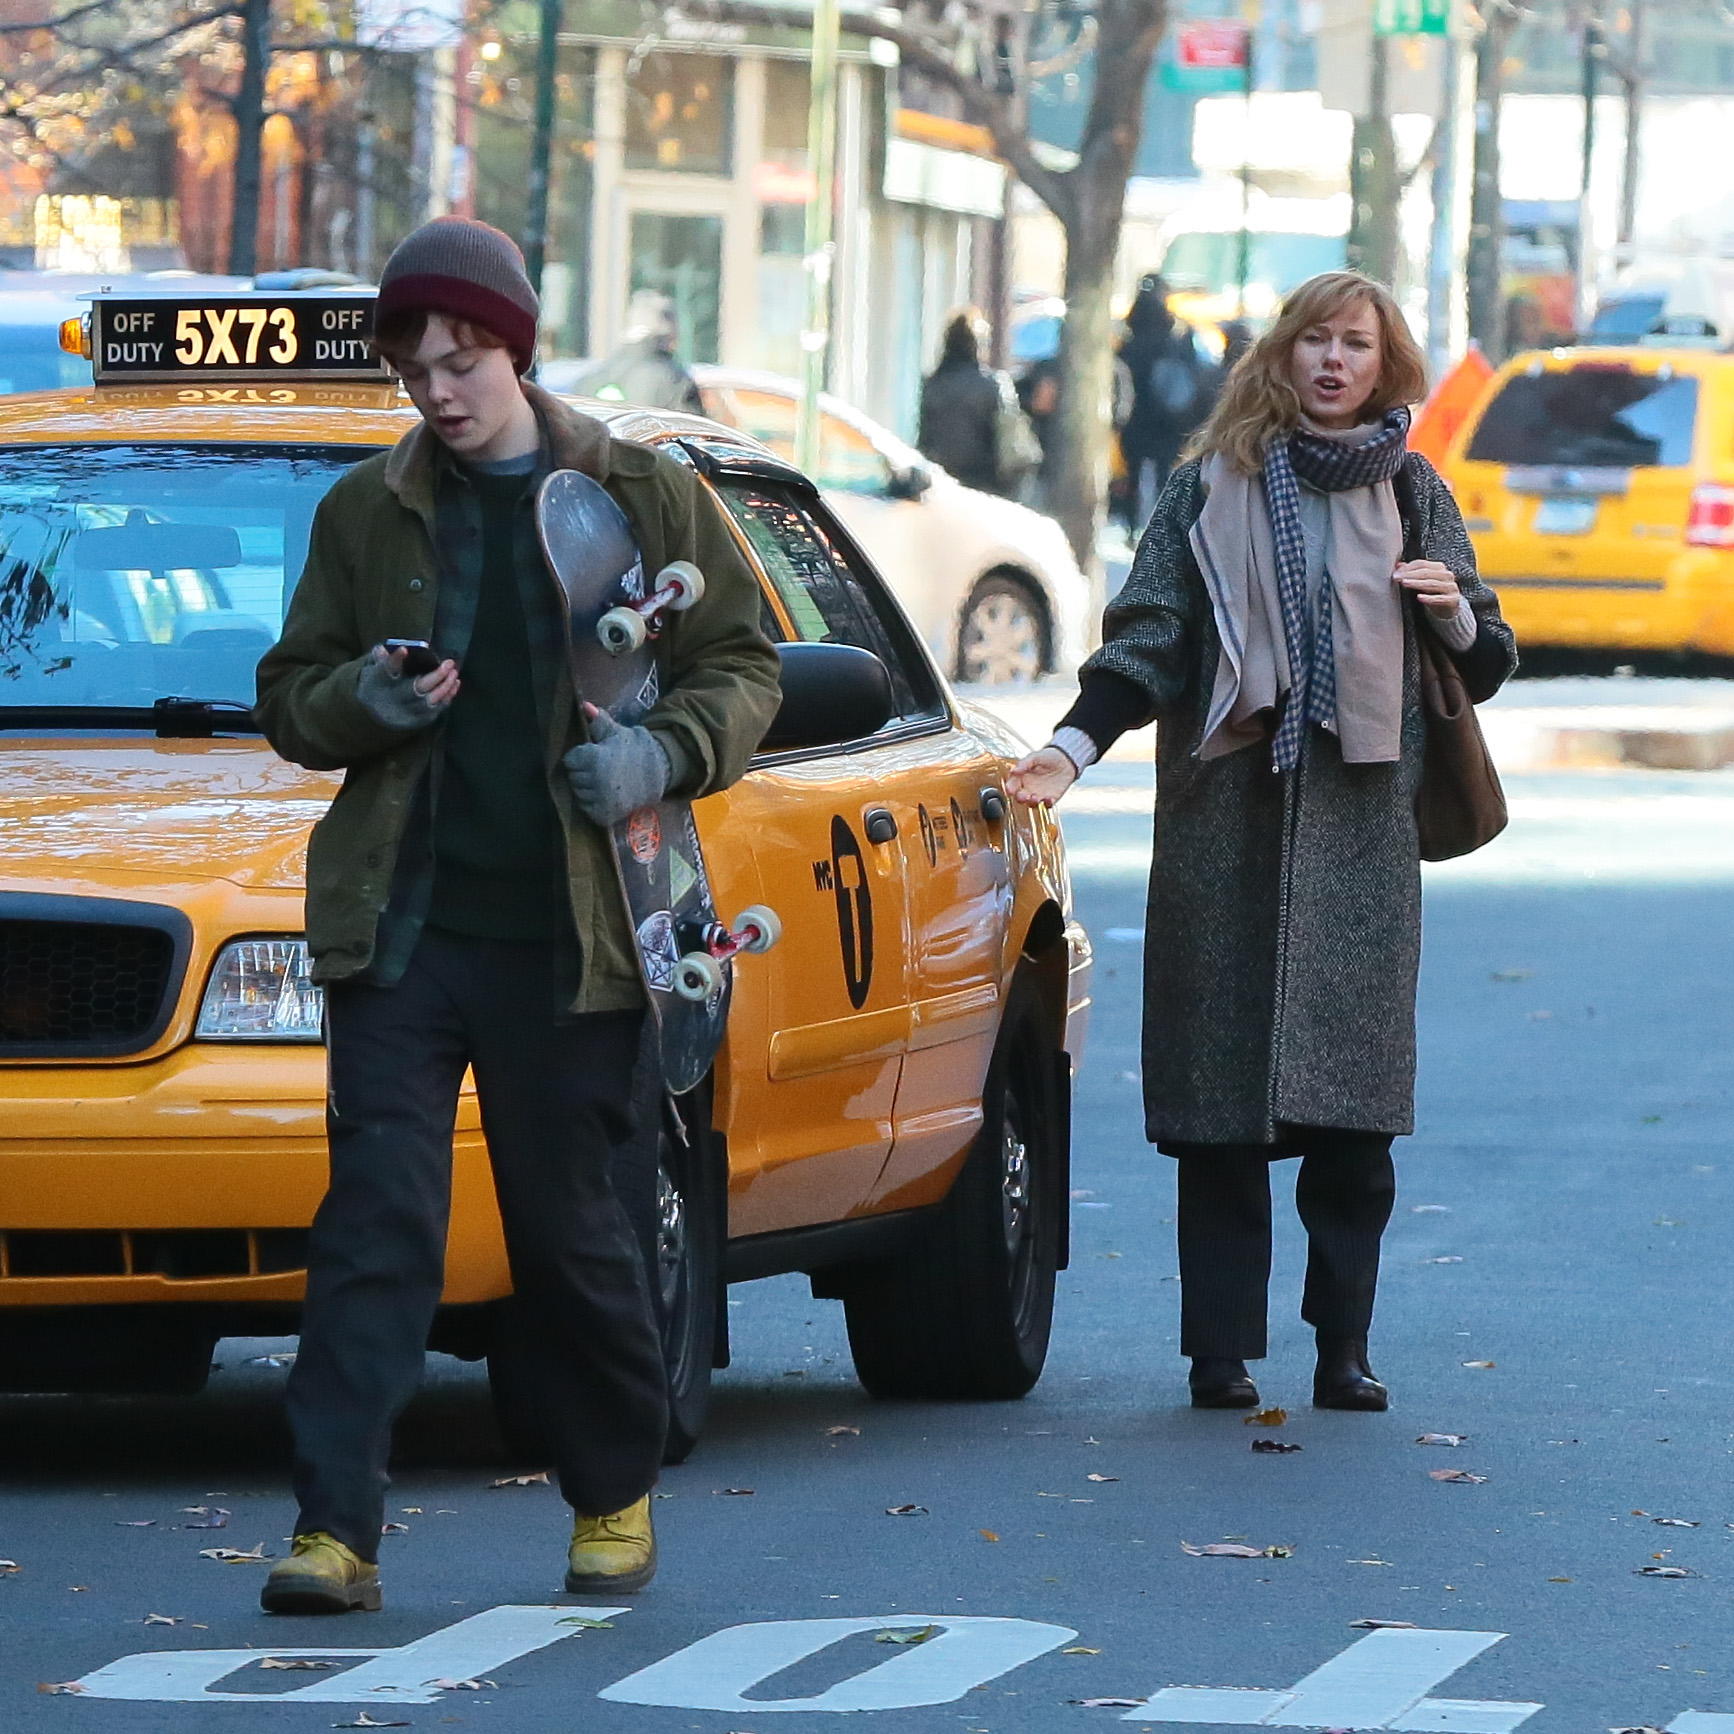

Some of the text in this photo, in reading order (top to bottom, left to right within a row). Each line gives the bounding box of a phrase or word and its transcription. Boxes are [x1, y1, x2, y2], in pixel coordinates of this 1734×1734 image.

[113, 312, 156, 333] OFF
[321, 310, 365, 330] OFF
[175, 307, 298, 365] 5X73
[107, 342, 164, 363] DUTY
[315, 339, 371, 360] DUTY
[80, 1605, 1734, 1734] TOP
